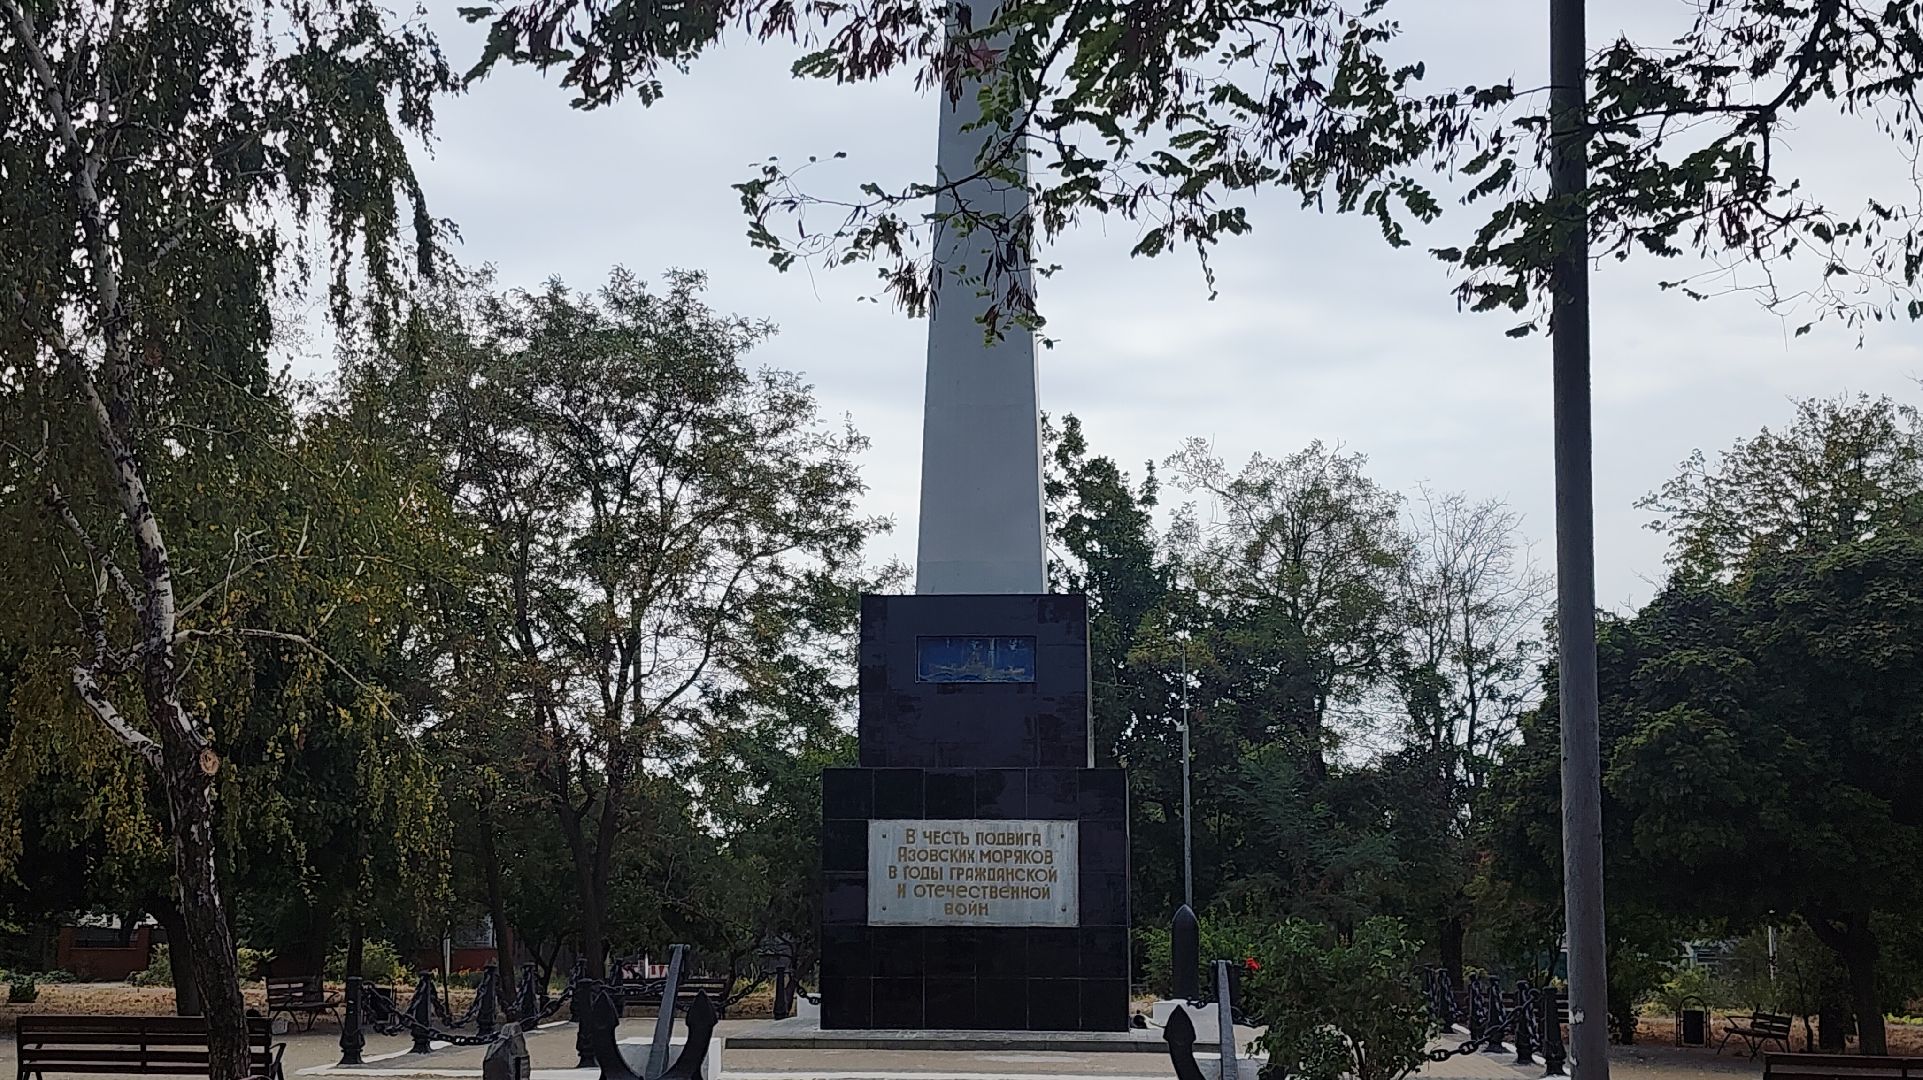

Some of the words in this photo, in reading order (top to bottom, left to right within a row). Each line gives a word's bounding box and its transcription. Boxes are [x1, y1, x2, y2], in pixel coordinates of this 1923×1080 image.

[906, 829, 916, 845] В
[923, 831, 970, 846] ЧЕСТЬ
[975, 832, 1042, 847] ПОДВИГА
[980, 850, 1054, 865] МОРЯКОВ
[888, 866, 898, 880] В
[903, 866, 943, 881] ГОДЫ
[950, 866, 1058, 883] ГРАЖДАНСКОЙ
[897, 883, 906, 898] И
[944, 900, 989, 916] ВОЙН
